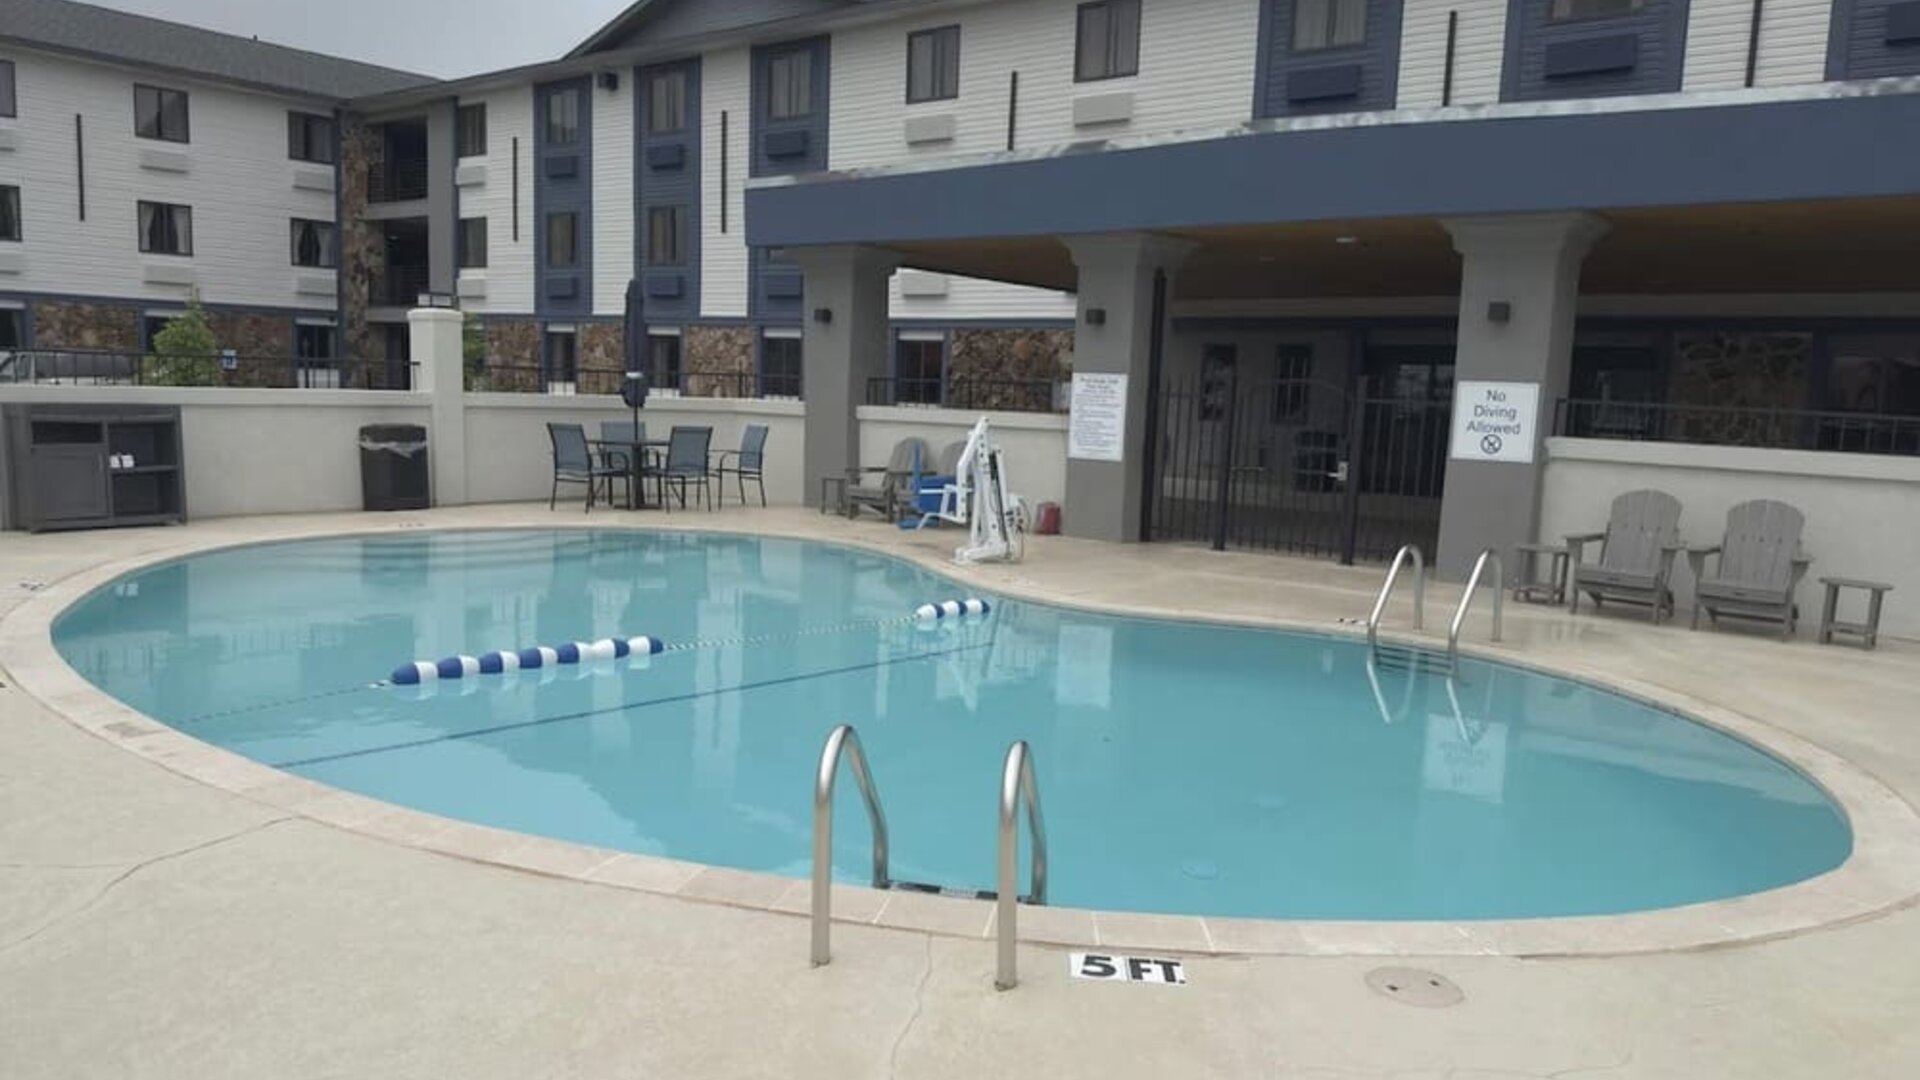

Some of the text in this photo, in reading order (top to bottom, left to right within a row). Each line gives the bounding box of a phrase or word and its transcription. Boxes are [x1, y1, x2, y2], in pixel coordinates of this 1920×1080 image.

[1487, 389, 1506, 402] No
[1474, 404, 1517, 422] Diving
[1466, 421, 1521, 435] Allowed
[1081, 954, 1186, 984] 5 FT.
